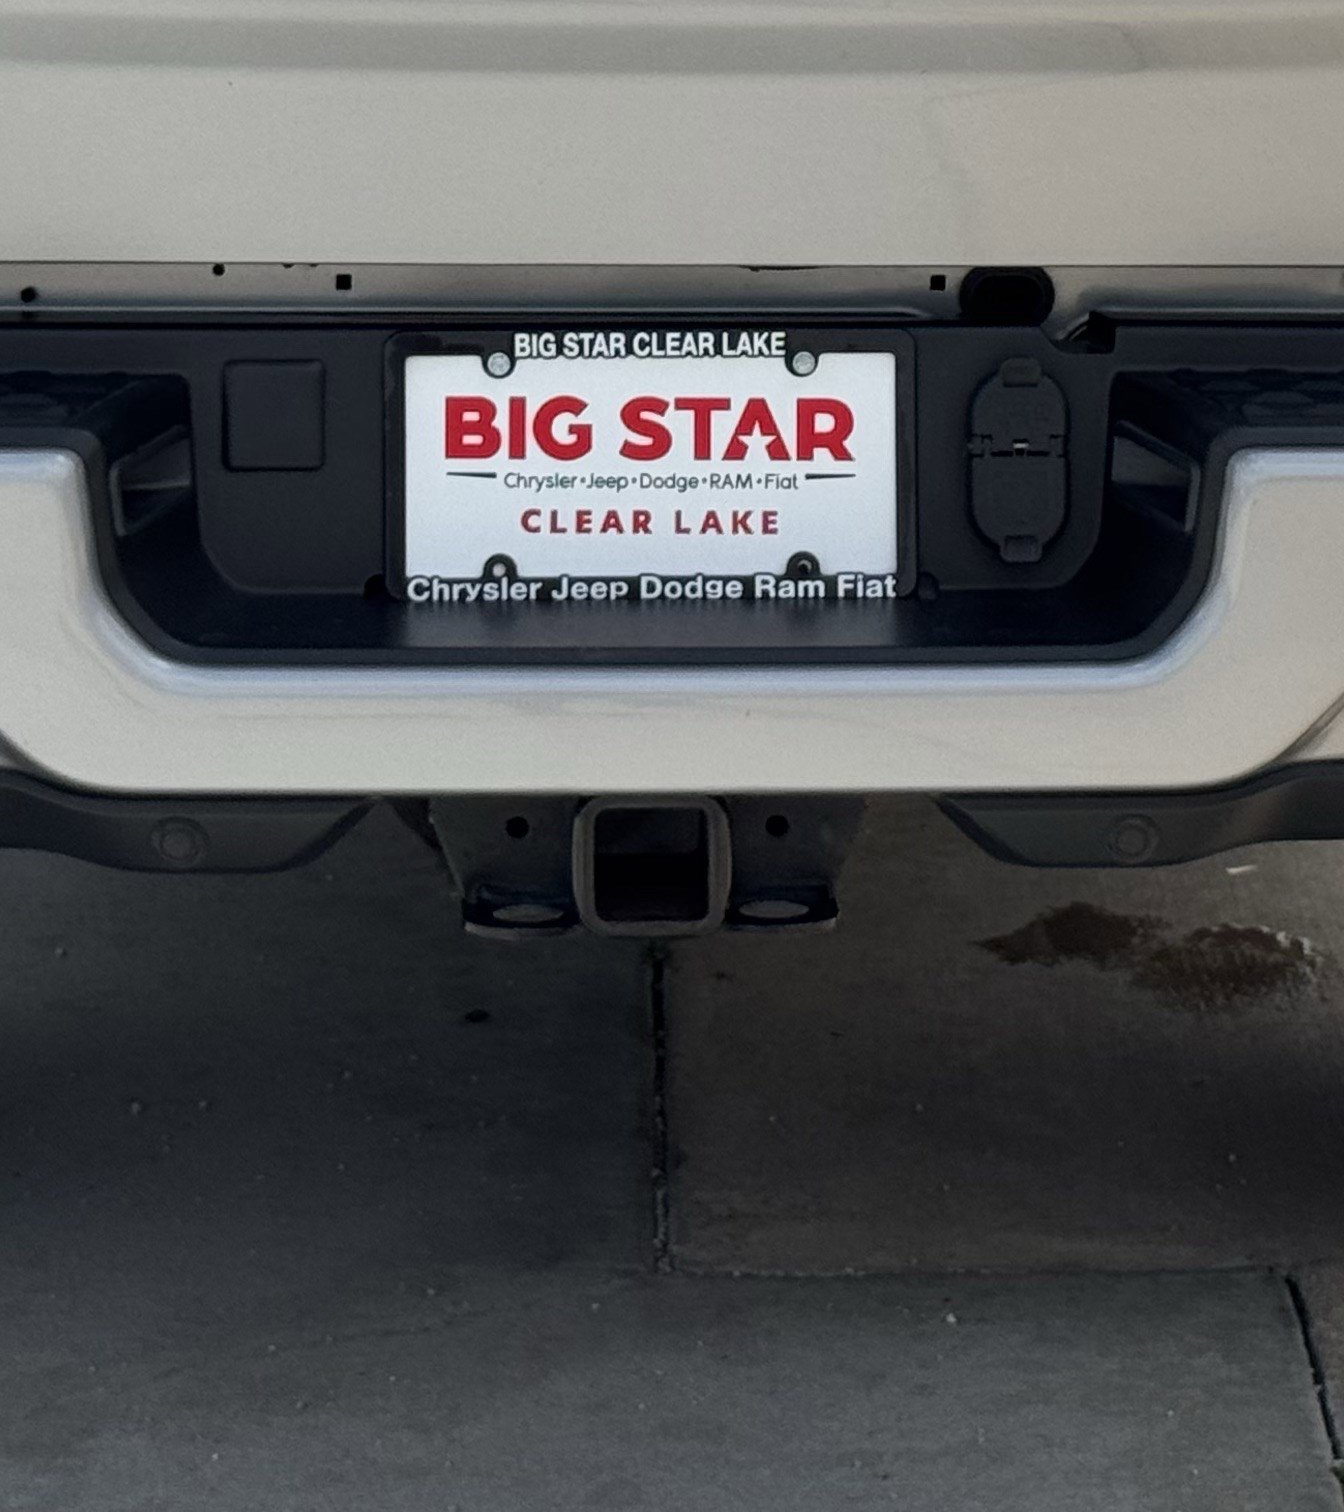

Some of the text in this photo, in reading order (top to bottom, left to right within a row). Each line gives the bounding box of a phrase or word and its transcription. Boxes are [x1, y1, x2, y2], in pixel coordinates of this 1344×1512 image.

[514, 332, 786, 358] BIG STAR CLEAR LAKE
[445, 396, 855, 461] BIG STAR
[520, 508, 779, 535] CLEAR LAKE
[408, 575, 897, 602] Chrysler Jeep Dodge Ram Fiat
